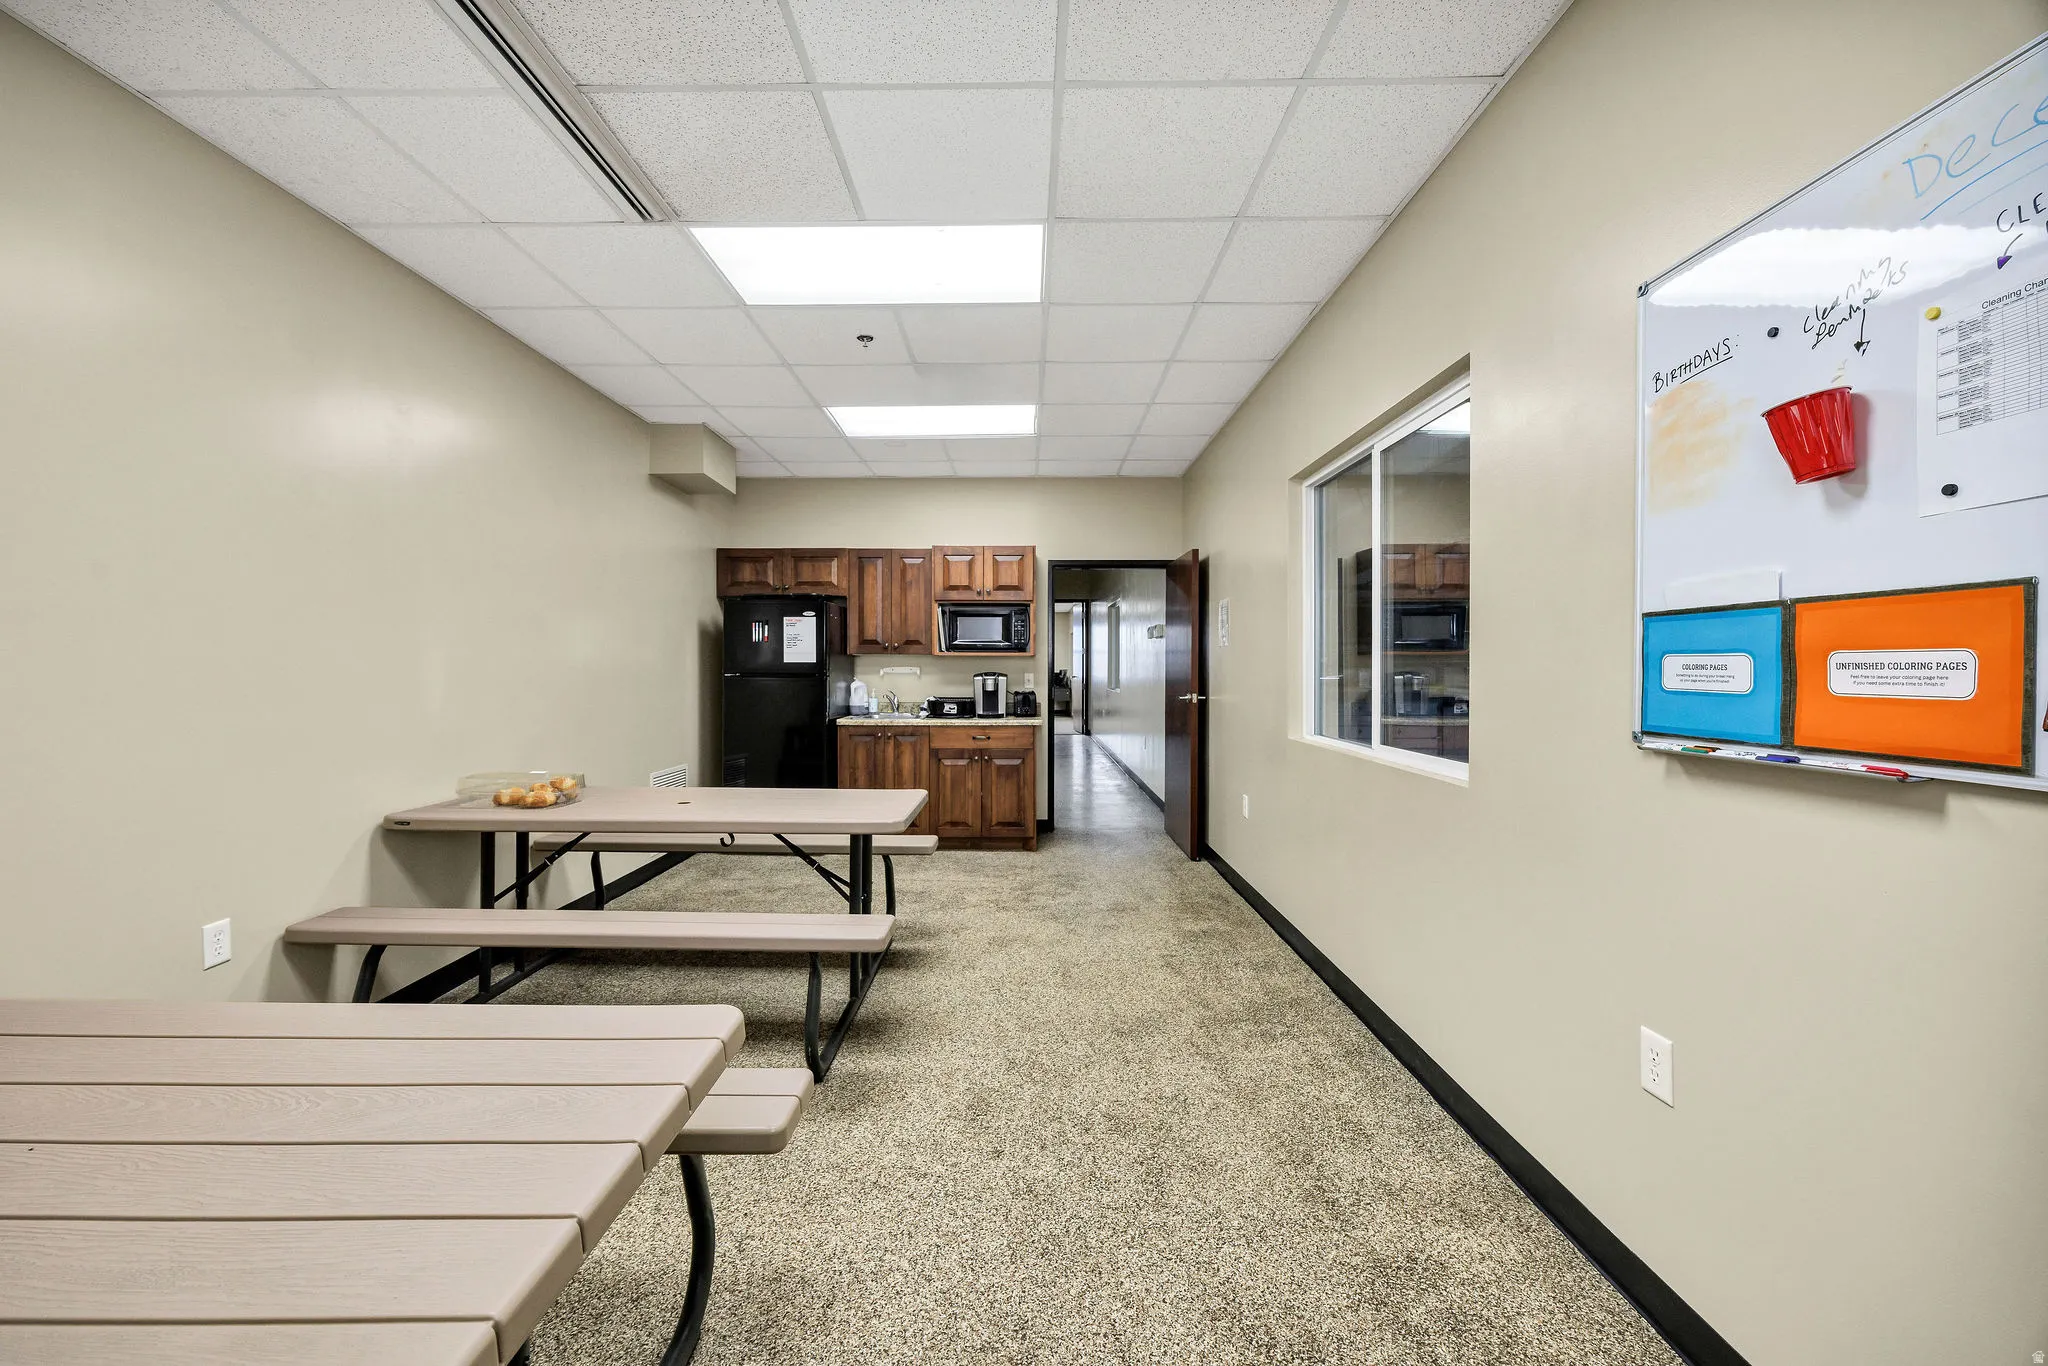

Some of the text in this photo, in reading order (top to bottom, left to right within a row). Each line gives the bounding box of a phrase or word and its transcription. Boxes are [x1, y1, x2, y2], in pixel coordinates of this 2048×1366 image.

[1981, 289, 2022, 310] Cleaning
[1835, 661, 1968, 671] UNFINISHED COLORING PAGES
